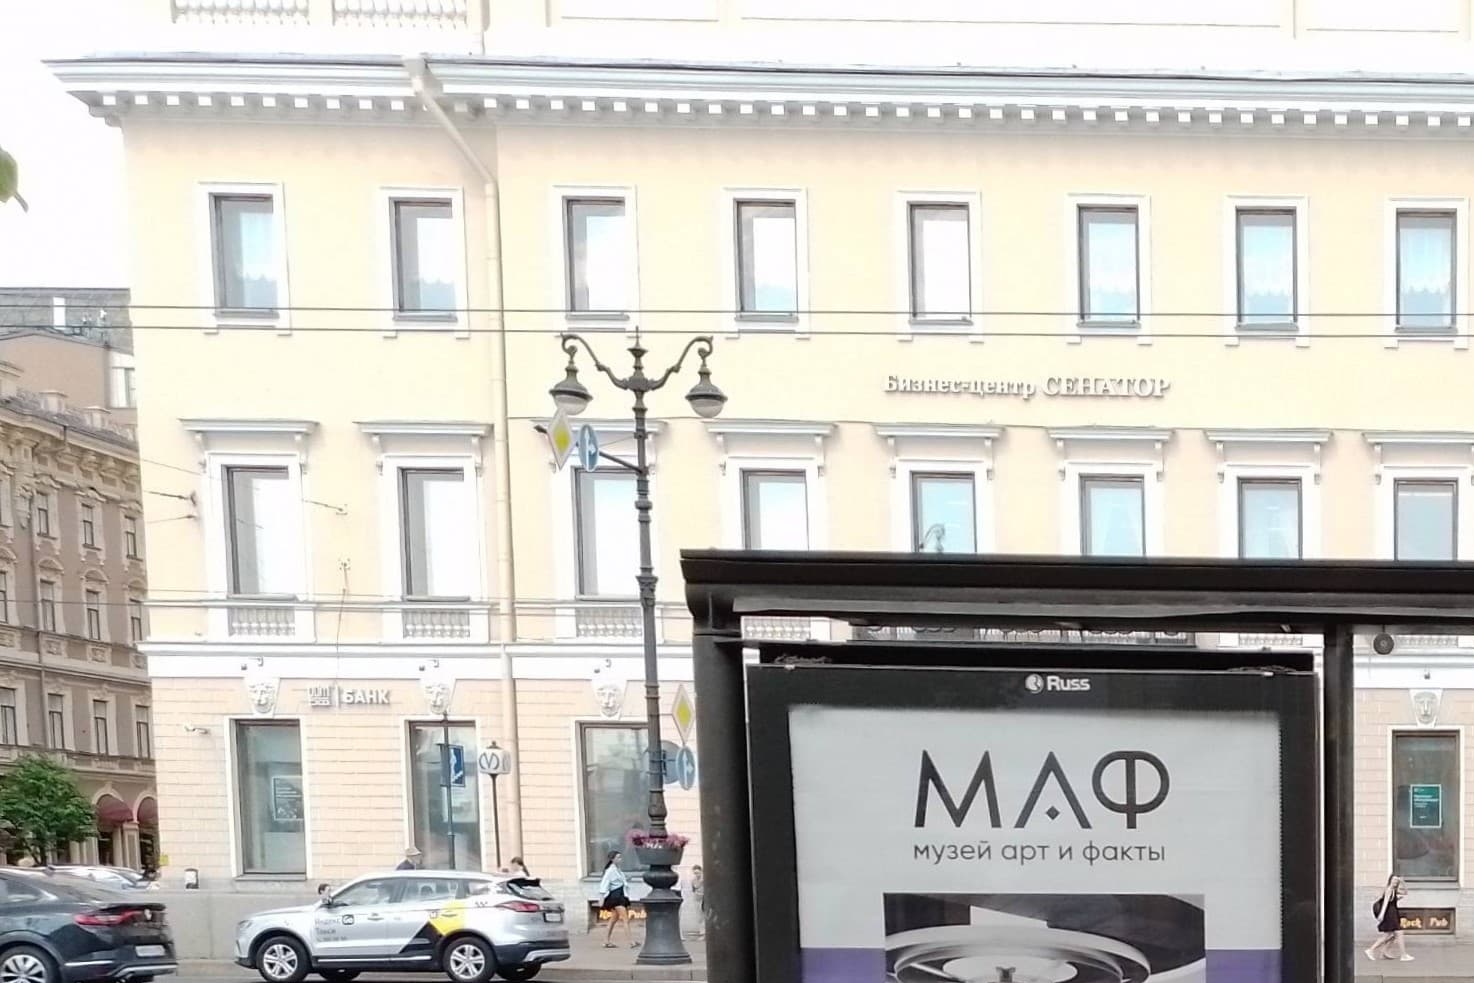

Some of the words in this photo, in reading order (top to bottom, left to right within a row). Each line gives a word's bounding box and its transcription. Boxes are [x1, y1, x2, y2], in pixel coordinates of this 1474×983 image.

[885, 375, 1036, 400] Бизнес-центр
[1043, 377, 1170, 397] СЕНАТОР
[343, 687, 391, 704] БАНК
[1046, 675, 1091, 691] Russ
[914, 749, 1170, 830] МАФ
[914, 840, 992, 865] музей
[1001, 843, 1048, 866] арт
[1058, 845, 1073, 861] и
[1082, 840, 1166, 867] факты
